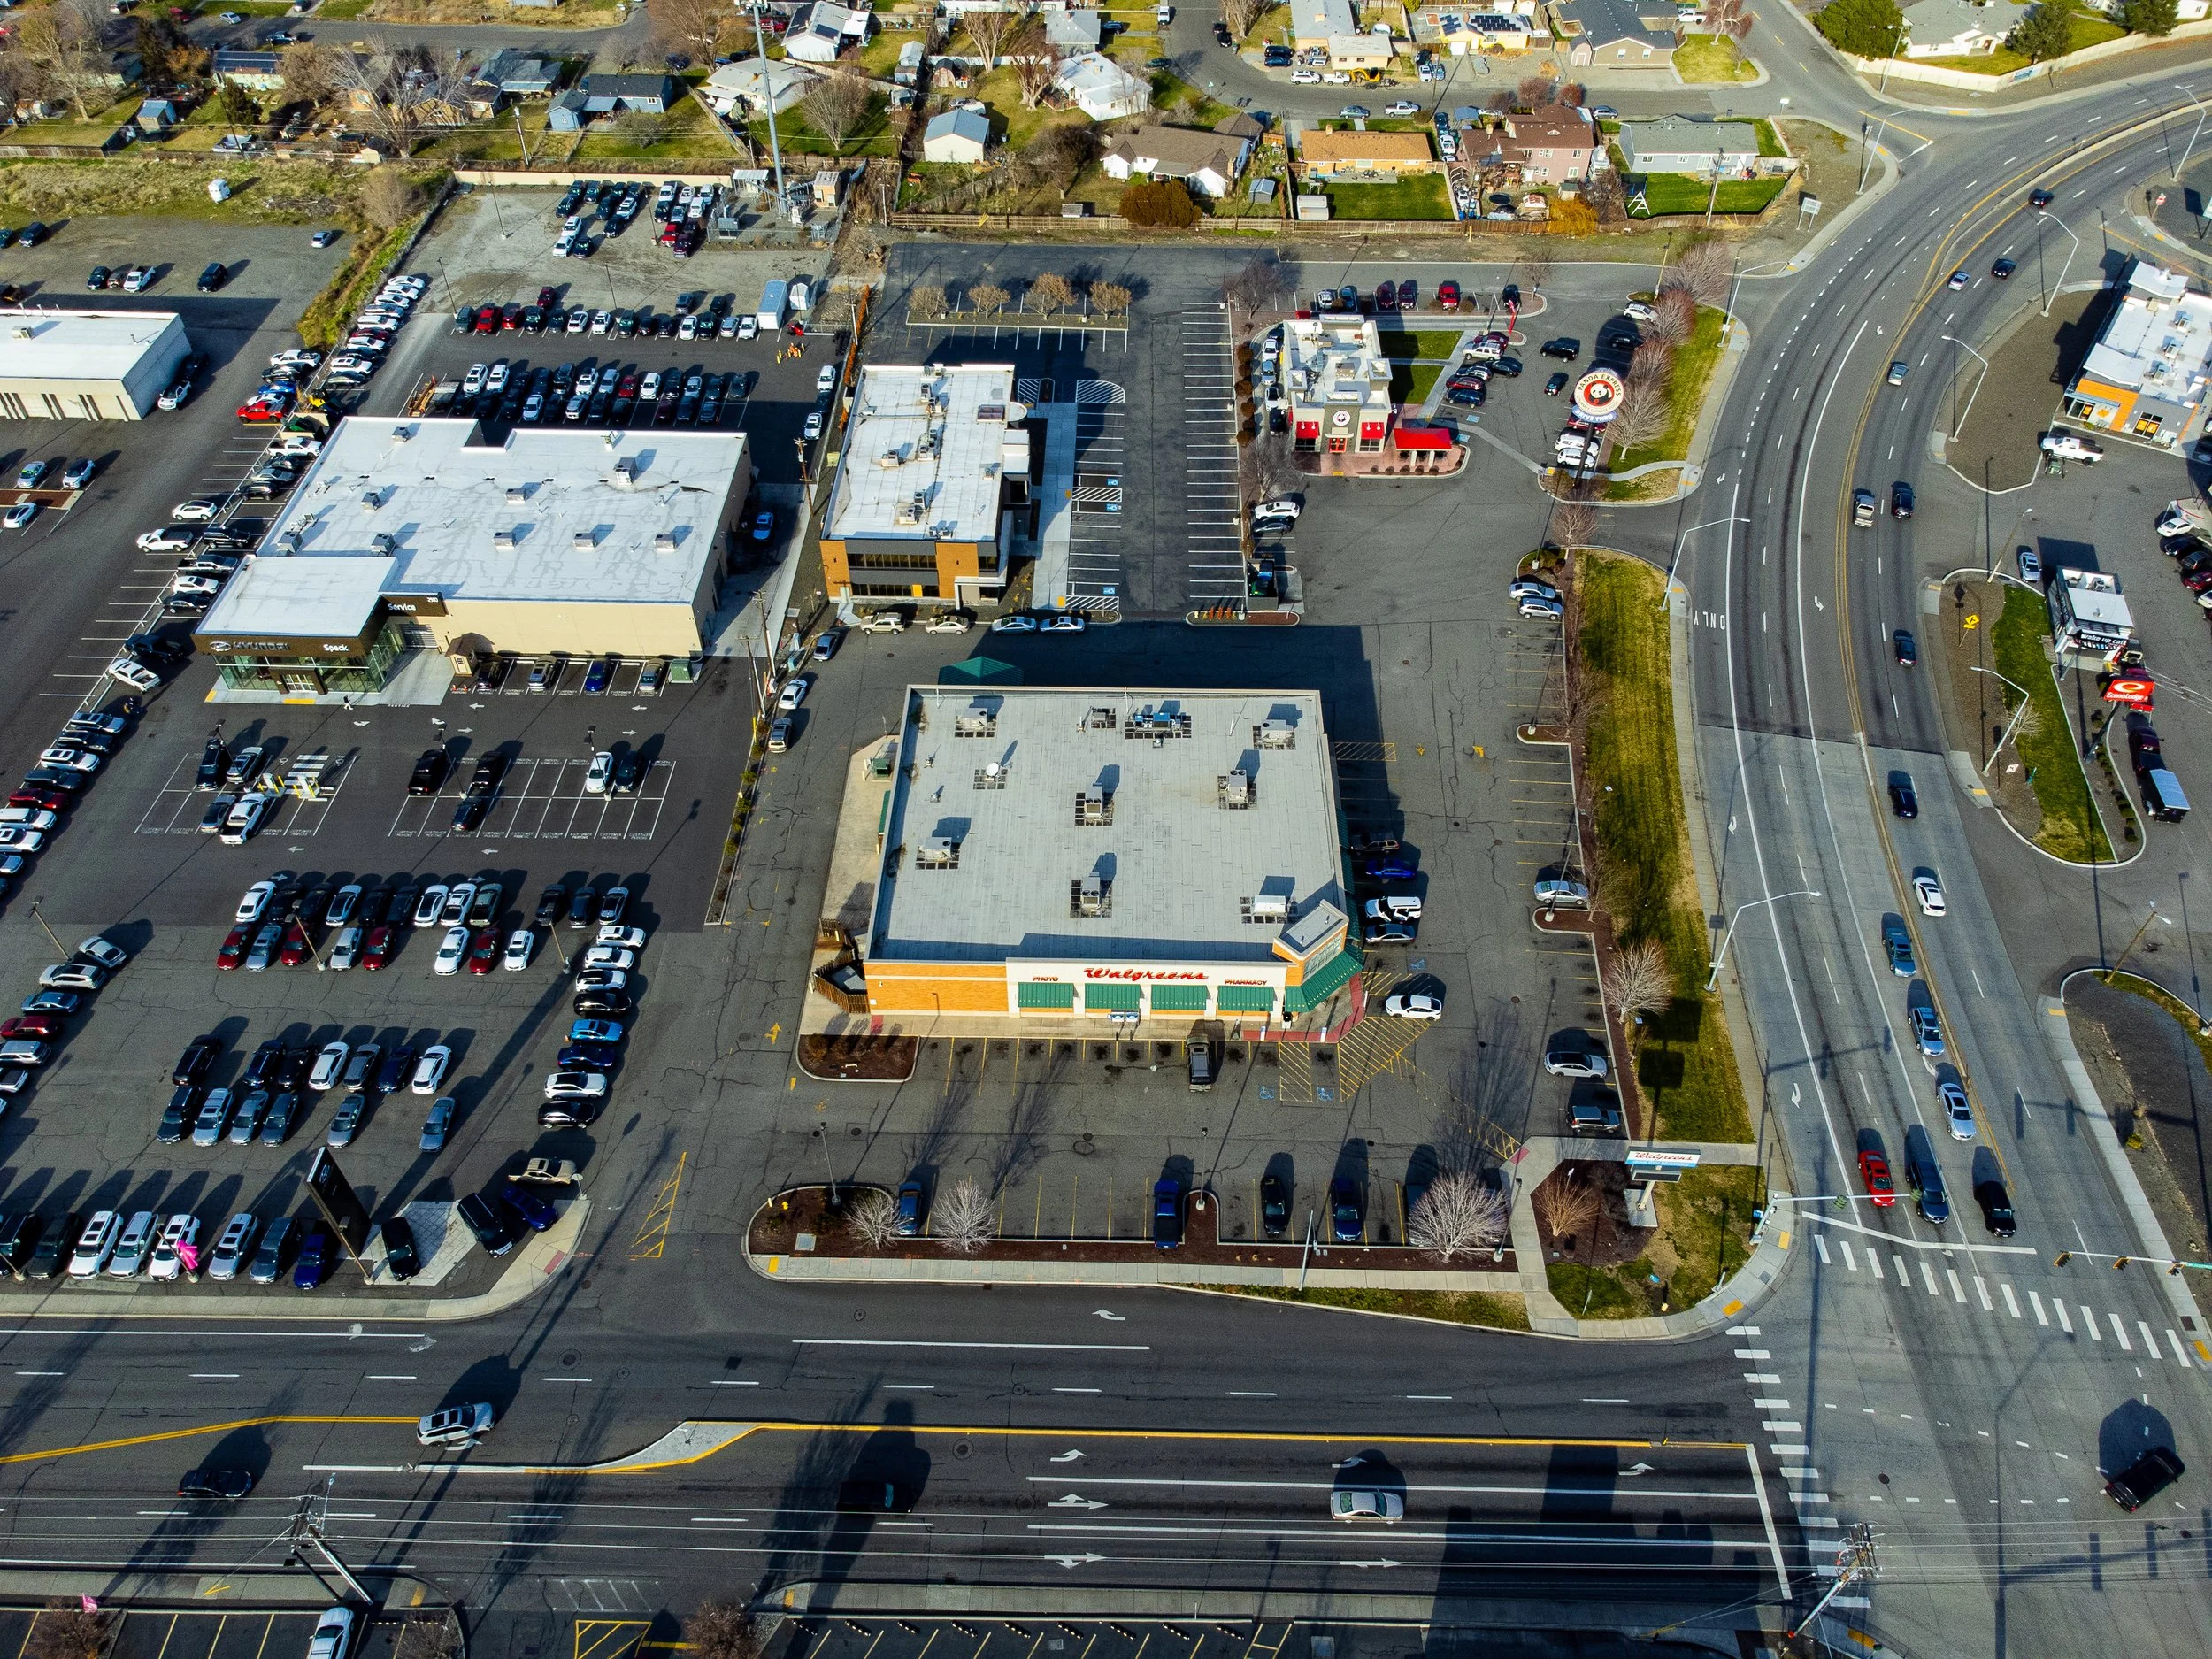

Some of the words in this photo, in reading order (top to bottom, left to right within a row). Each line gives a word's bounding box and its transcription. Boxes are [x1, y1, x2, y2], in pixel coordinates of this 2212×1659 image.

[1578, 373, 1599, 390] PANDA
[1601, 373, 1622, 396] EXPRESS
[1694, 610, 1726, 630] ONLY
[2101, 635, 2112, 644] up
[233, 641, 291, 651] HYUNDAI
[322, 643, 349, 652] Speck
[1084, 968, 1209, 981] Walgreens
[1634, 1152, 1694, 1161] Walgreens
